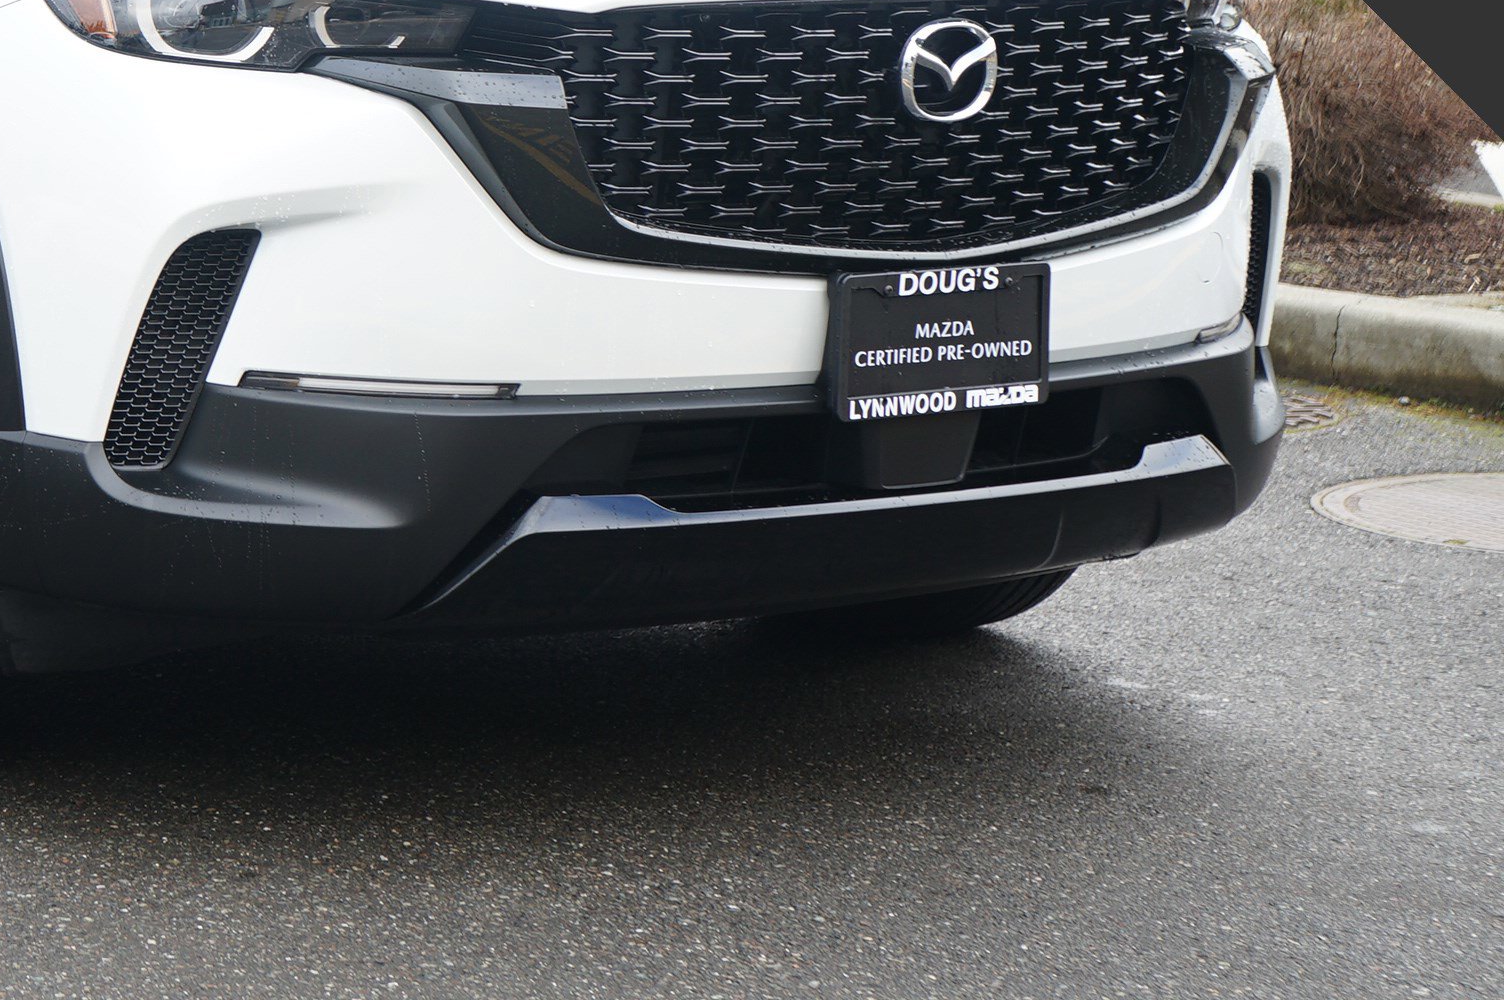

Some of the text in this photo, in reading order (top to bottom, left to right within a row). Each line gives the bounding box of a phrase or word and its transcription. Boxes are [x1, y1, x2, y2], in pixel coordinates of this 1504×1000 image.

[898, 266, 999, 297] DOUG'S
[915, 320, 974, 339] MAZDA
[854, 339, 1032, 368] CERTIFIED PRE-OWNED
[849, 391, 957, 420] LYNNWOOD
